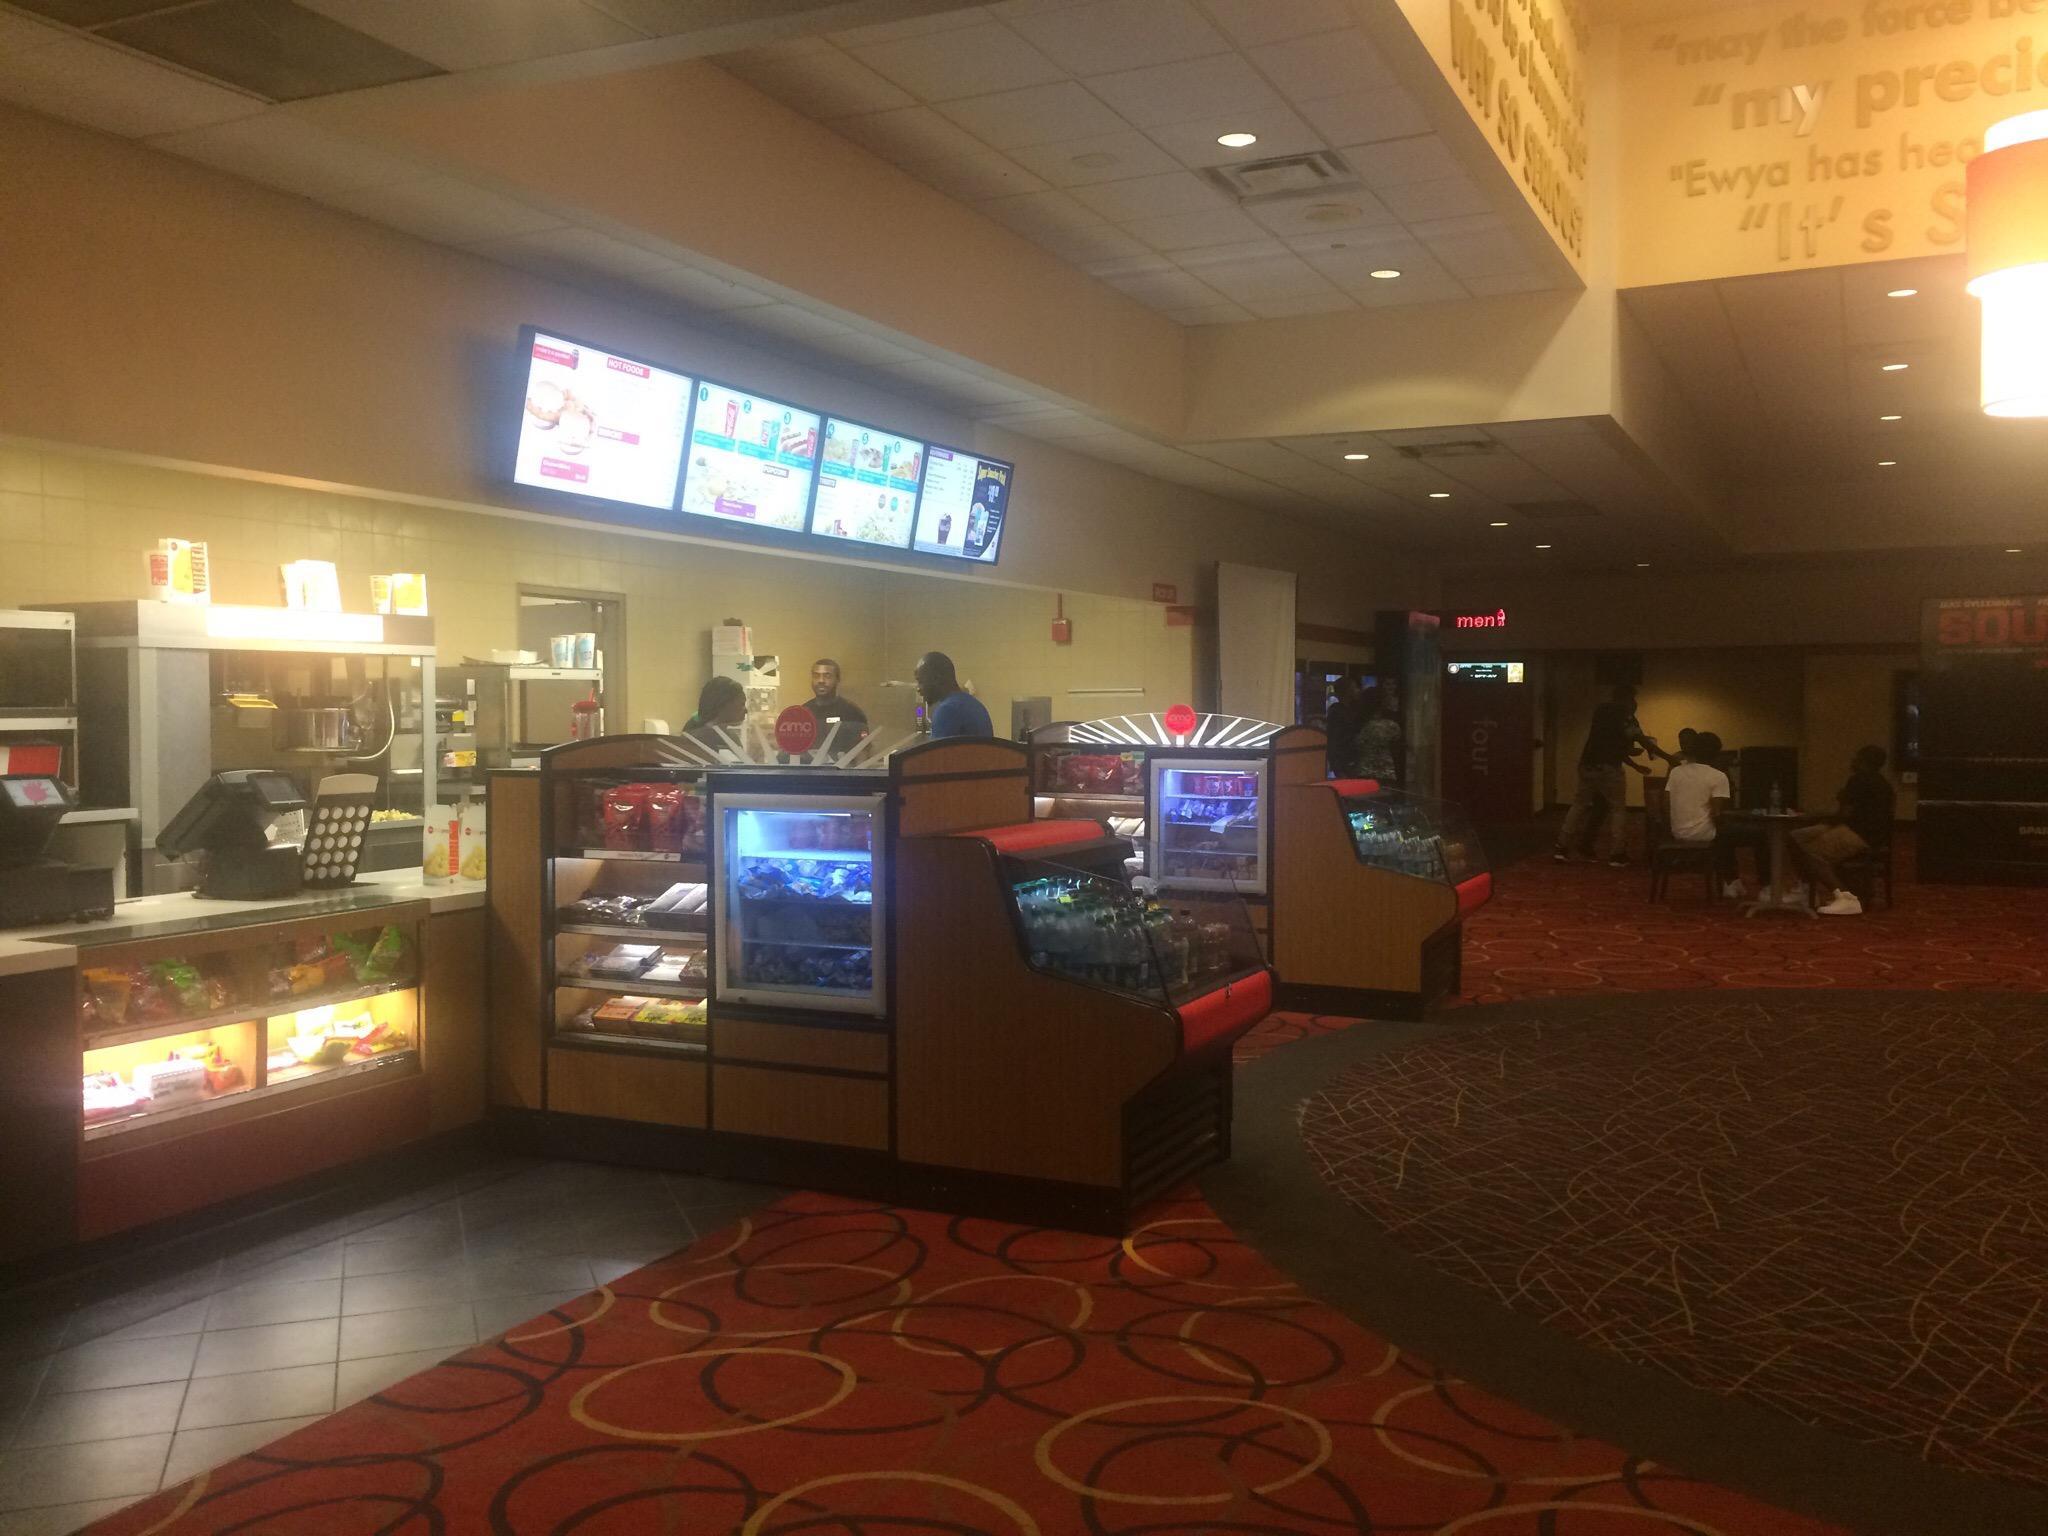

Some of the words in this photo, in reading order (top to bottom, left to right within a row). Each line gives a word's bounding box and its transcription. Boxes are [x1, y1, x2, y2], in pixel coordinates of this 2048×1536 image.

[1777, 12, 1849, 50] the
[1862, 0, 1973, 38] force
[1807, 144, 1883, 182] has
[1456, 615, 1495, 628] men
[779, 721, 812, 732] amc
[1472, 719, 1498, 776] four
